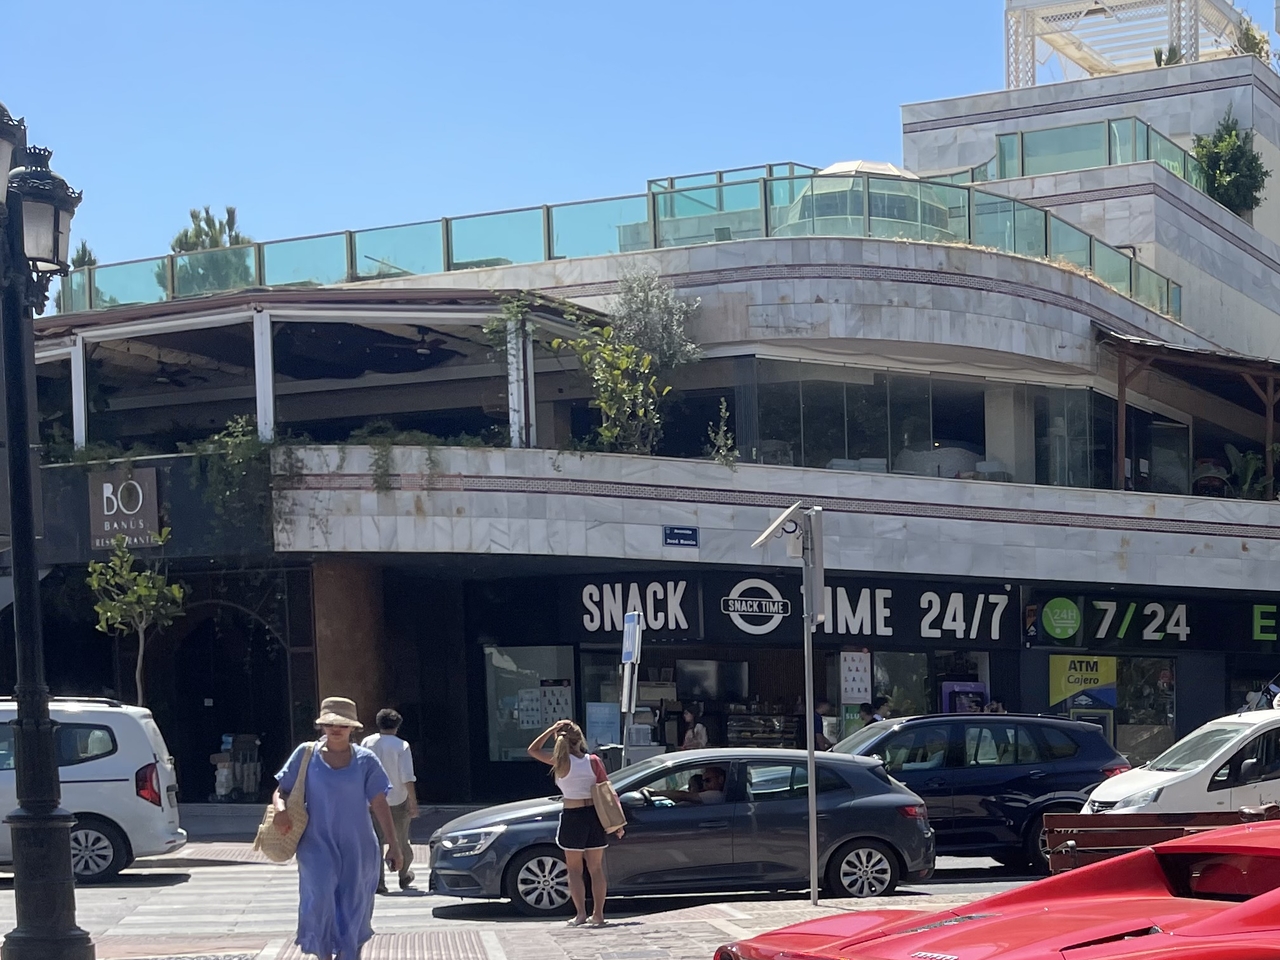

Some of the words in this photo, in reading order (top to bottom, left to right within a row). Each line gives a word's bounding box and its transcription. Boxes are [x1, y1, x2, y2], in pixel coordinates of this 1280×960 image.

[102, 480, 143, 515] BO
[104, 517, 144, 531] BANÚS
[95, 535, 155, 547] RESRANTE
[582, 580, 689, 632] SNACK
[800, 584, 893, 636] IME
[919, 591, 1009, 641] 24/7
[728, 599, 759, 613] SNACK
[762, 601, 784, 614] TIME
[1053, 609, 1077, 620] 24H
[1092, 601, 1191, 642] 7/24
[1068, 660, 1099, 673] ATM
[1067, 674, 1100, 687] Cajero
